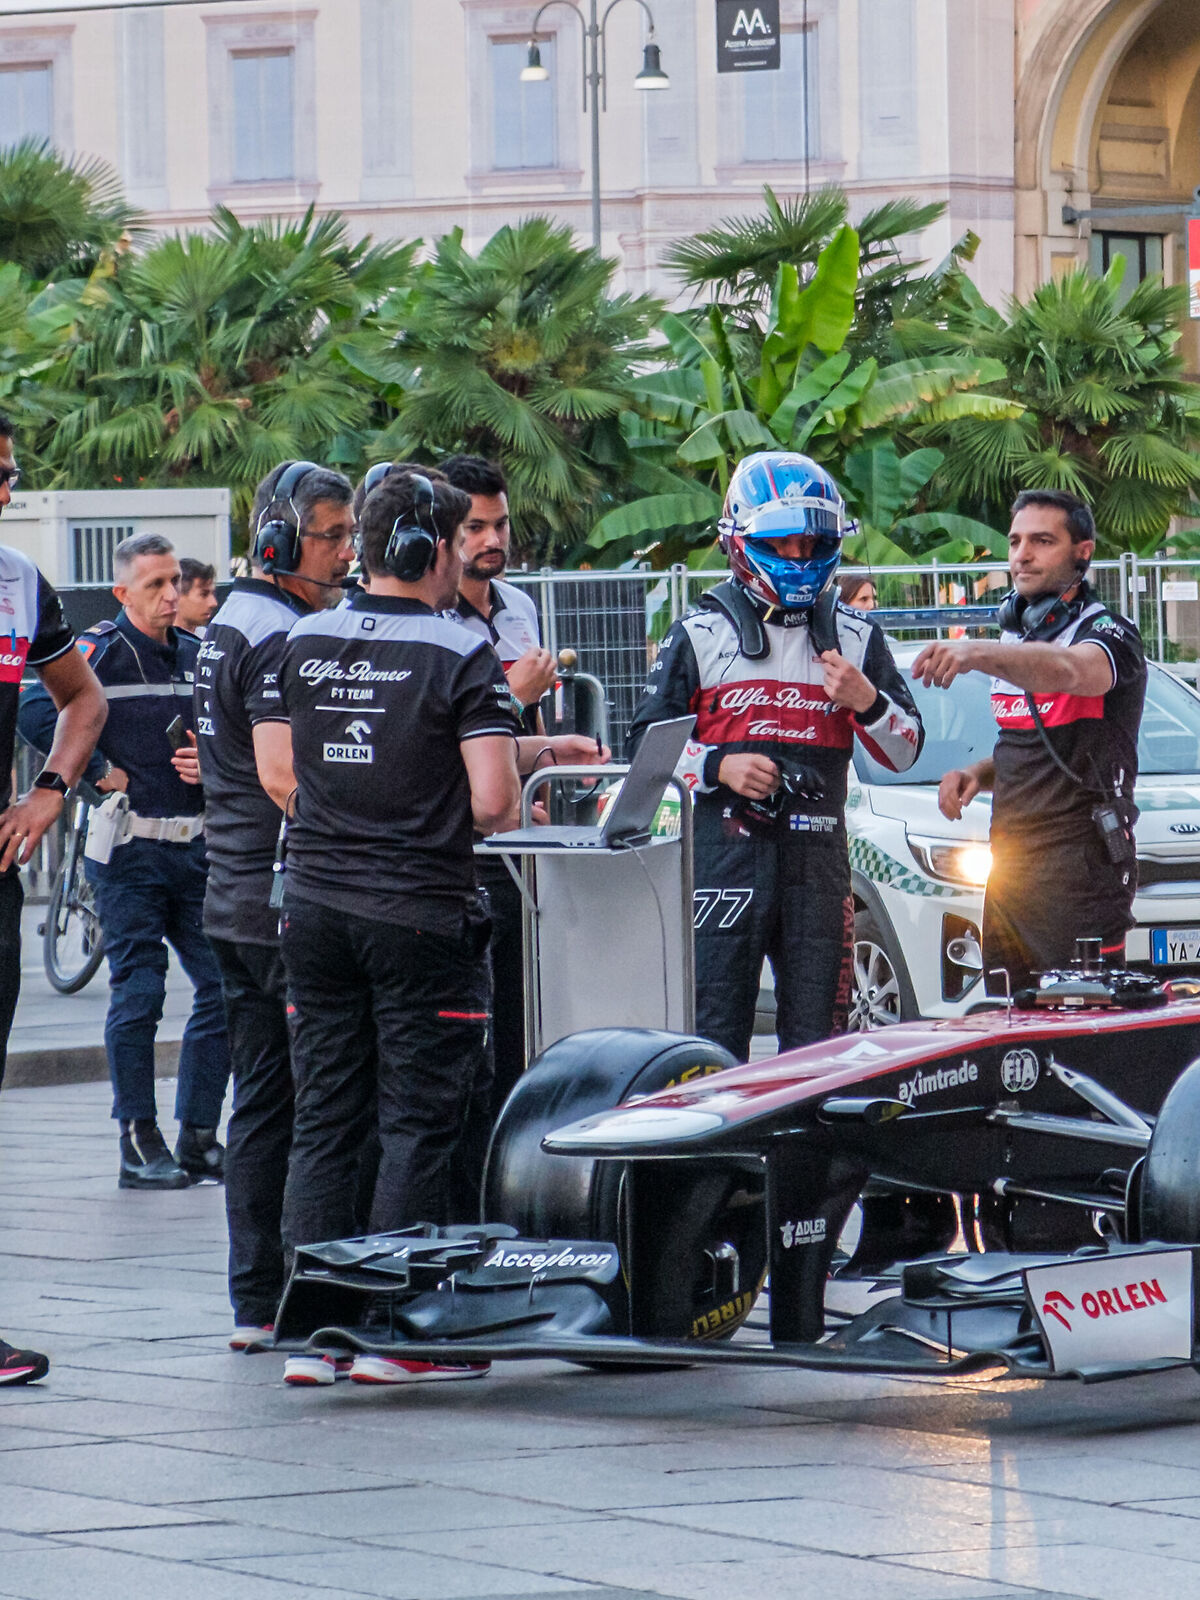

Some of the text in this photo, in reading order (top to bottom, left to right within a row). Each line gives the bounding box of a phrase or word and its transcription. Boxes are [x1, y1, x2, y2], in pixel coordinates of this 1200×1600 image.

[299, 659, 412, 686] Alfa Romeo
[331, 687, 373, 700] F1 TEAM
[720, 687, 774, 715] Alfa
[748, 720, 818, 740] Tonale
[327, 746, 368, 760] ORLEN
[1173, 823, 1199, 833] KIA
[693, 889, 754, 928] 77
[1170, 943, 1188, 961] YA
[795, 1218, 826, 1237] ADLER
[1081, 1278, 1168, 1319] ORLEN
